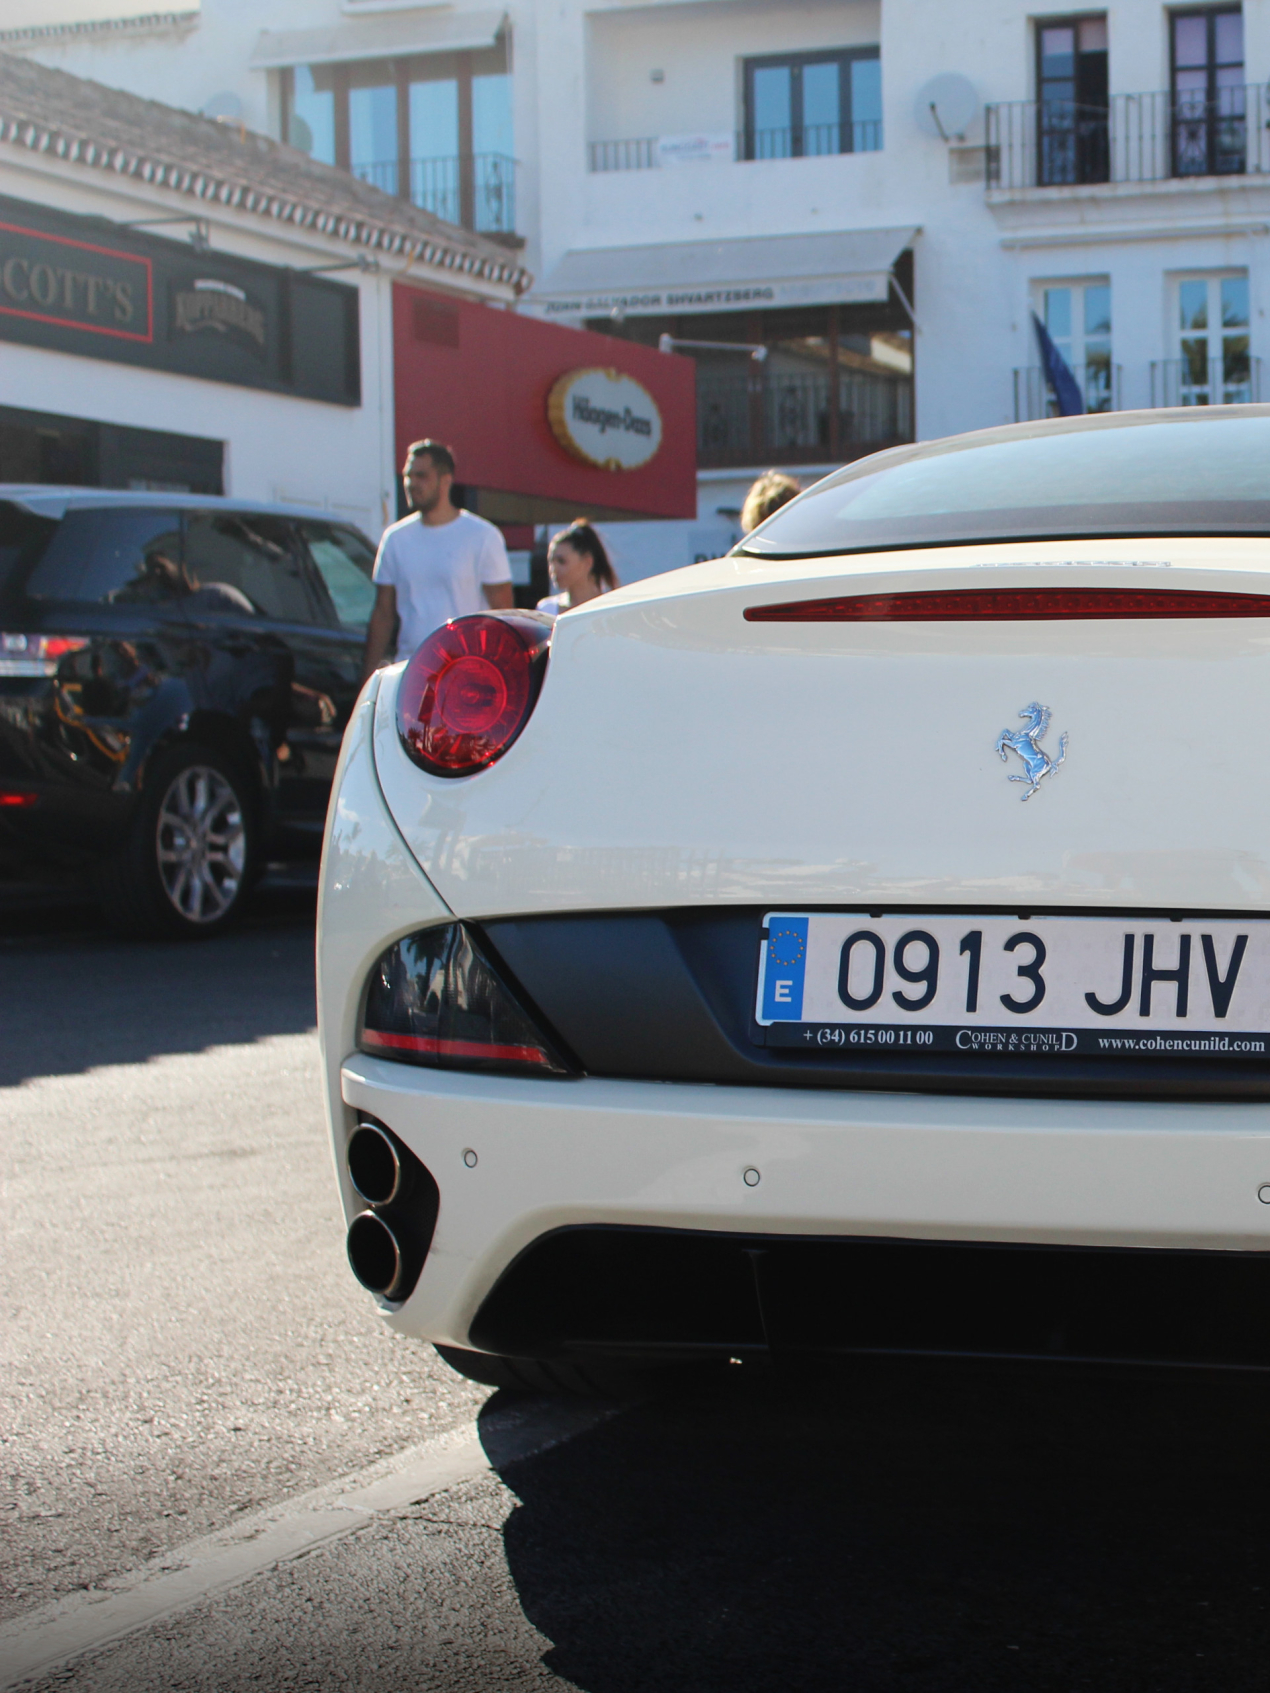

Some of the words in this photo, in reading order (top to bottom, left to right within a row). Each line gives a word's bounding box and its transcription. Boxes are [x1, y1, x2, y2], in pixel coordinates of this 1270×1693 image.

[0, 258, 133, 321] COTT'S
[837, 929, 1048, 1014] 0913
[1084, 932, 1249, 1019] JHV
[775, 980, 792, 1002] E
[817, 1029, 845, 1045] (34)
[1009, 1033, 1018, 1043] &
[1098, 1036, 1265, 1052] www.cohencunild.com
[972, 1043, 1060, 1051] WORKSHOP
